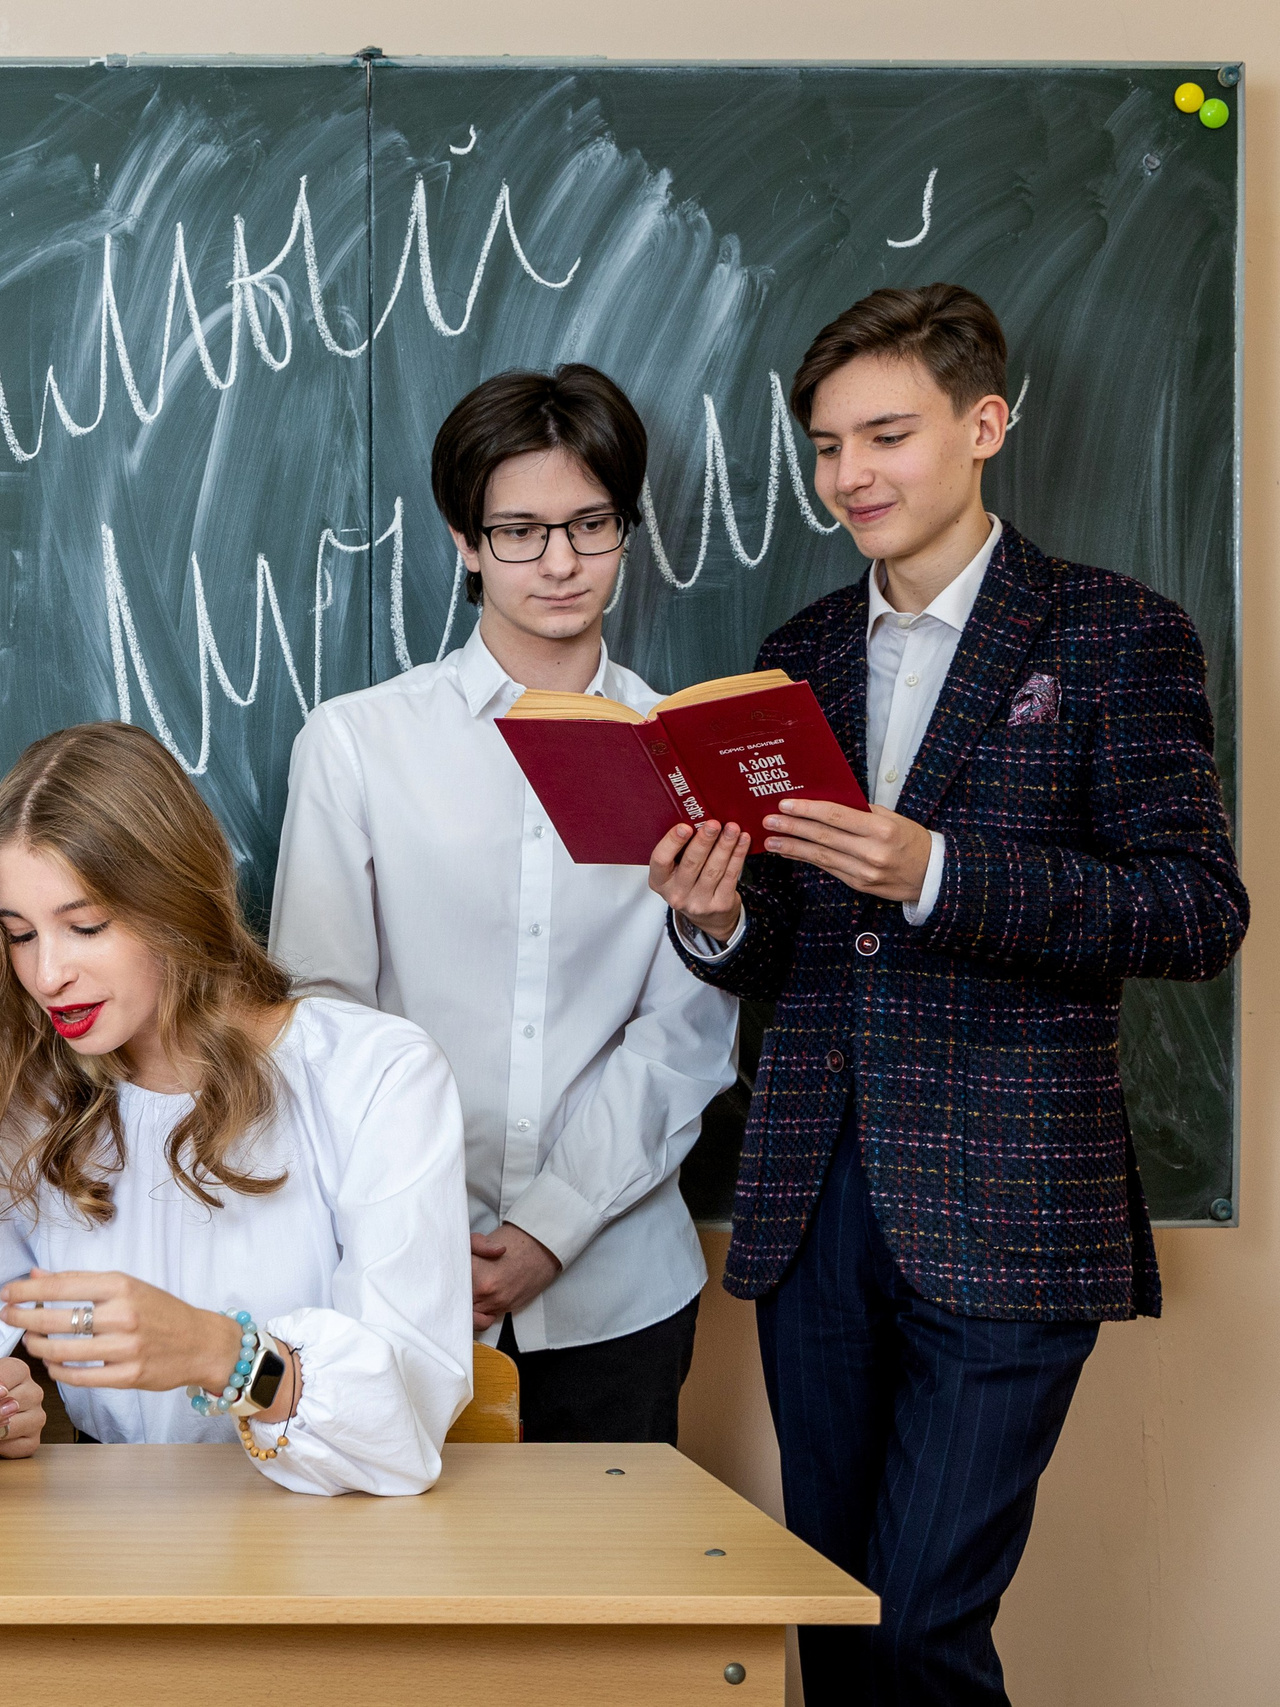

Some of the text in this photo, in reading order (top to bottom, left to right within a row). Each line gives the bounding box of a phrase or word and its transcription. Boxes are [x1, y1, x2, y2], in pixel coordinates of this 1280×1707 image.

[719, 738, 785, 756] БОРИС ВАСИЛЬЕВ
[738, 754, 786, 773] А ЗОРИ
[745, 767, 789, 785] ЗДЕСЬ
[749, 780, 805, 798] ТИХИЕ...
